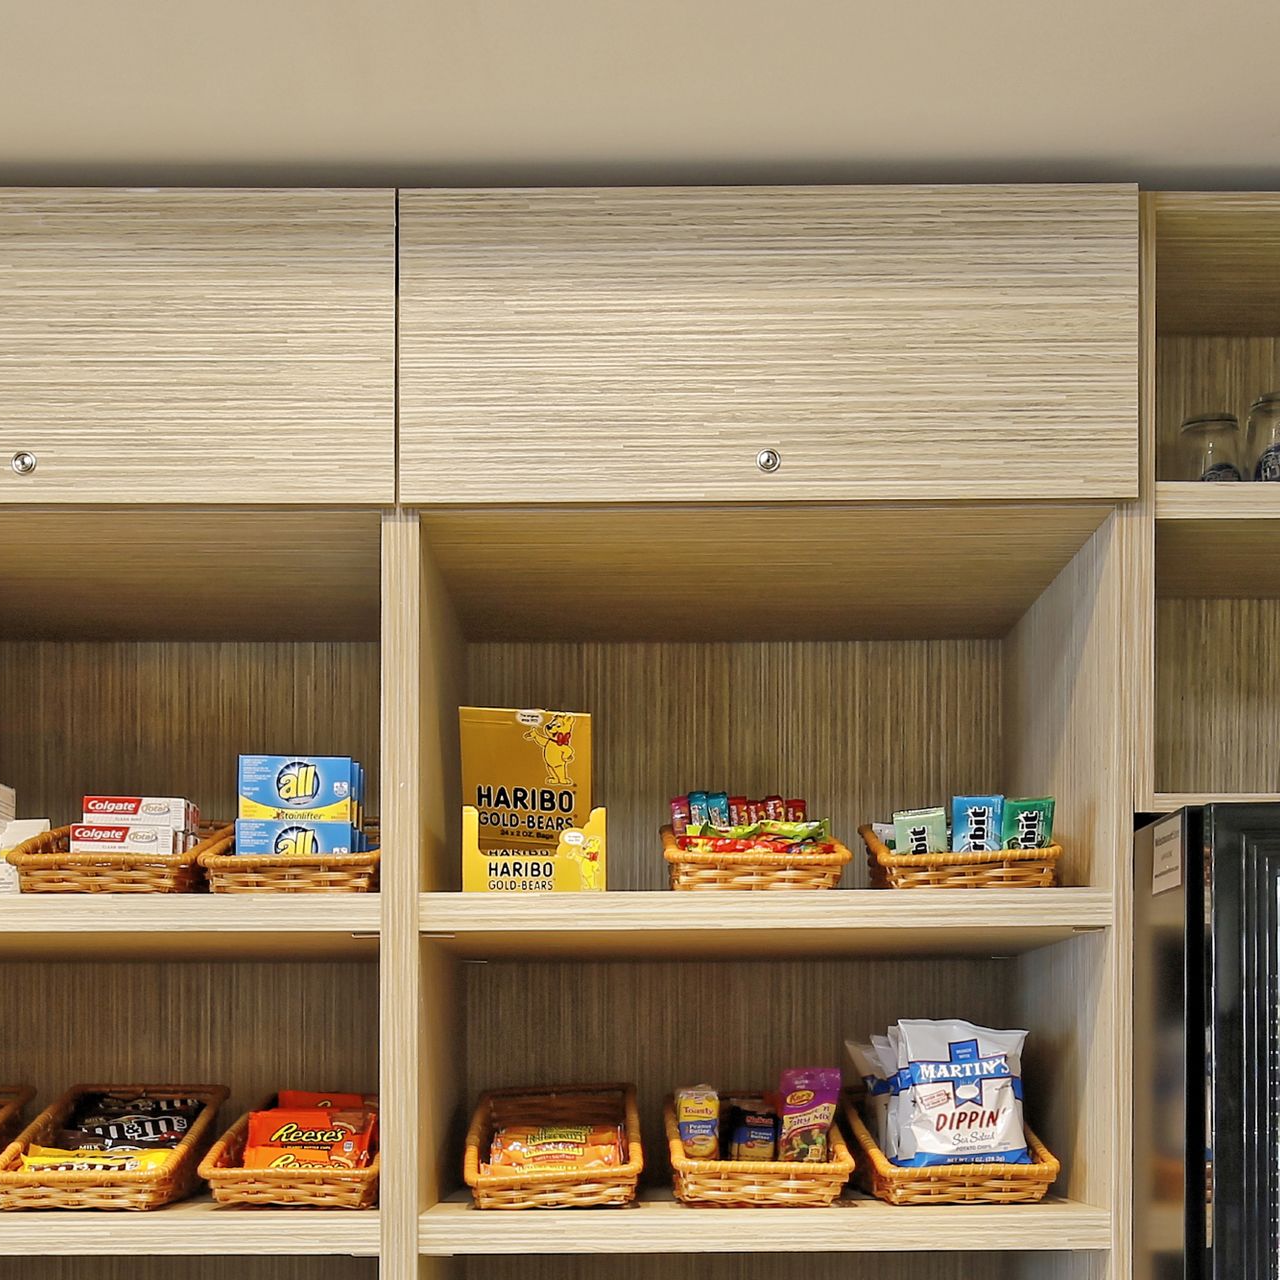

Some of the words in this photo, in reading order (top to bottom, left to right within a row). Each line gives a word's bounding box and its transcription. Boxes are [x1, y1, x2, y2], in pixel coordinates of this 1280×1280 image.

[279, 765, 317, 800] all
[88, 800, 136, 812] Colgate
[477, 784, 575, 814] HARIBO
[478, 812, 574, 831] GOLD-BEARS
[970, 806, 988, 852] rbit
[1019, 811, 1039, 850] rbit
[75, 827, 124, 840] Colgate
[277, 829, 316, 855] all
[910, 826, 928, 855] bit
[488, 861, 554, 878] HARIBO
[488, 880, 554, 891] GOLD-BEARS
[920, 1057, 1010, 1079] MARTIN'S
[936, 1107, 1007, 1132] DIPPIN'
[271, 1123, 347, 1142] Reese's
[952, 1133, 969, 1146] Sea
